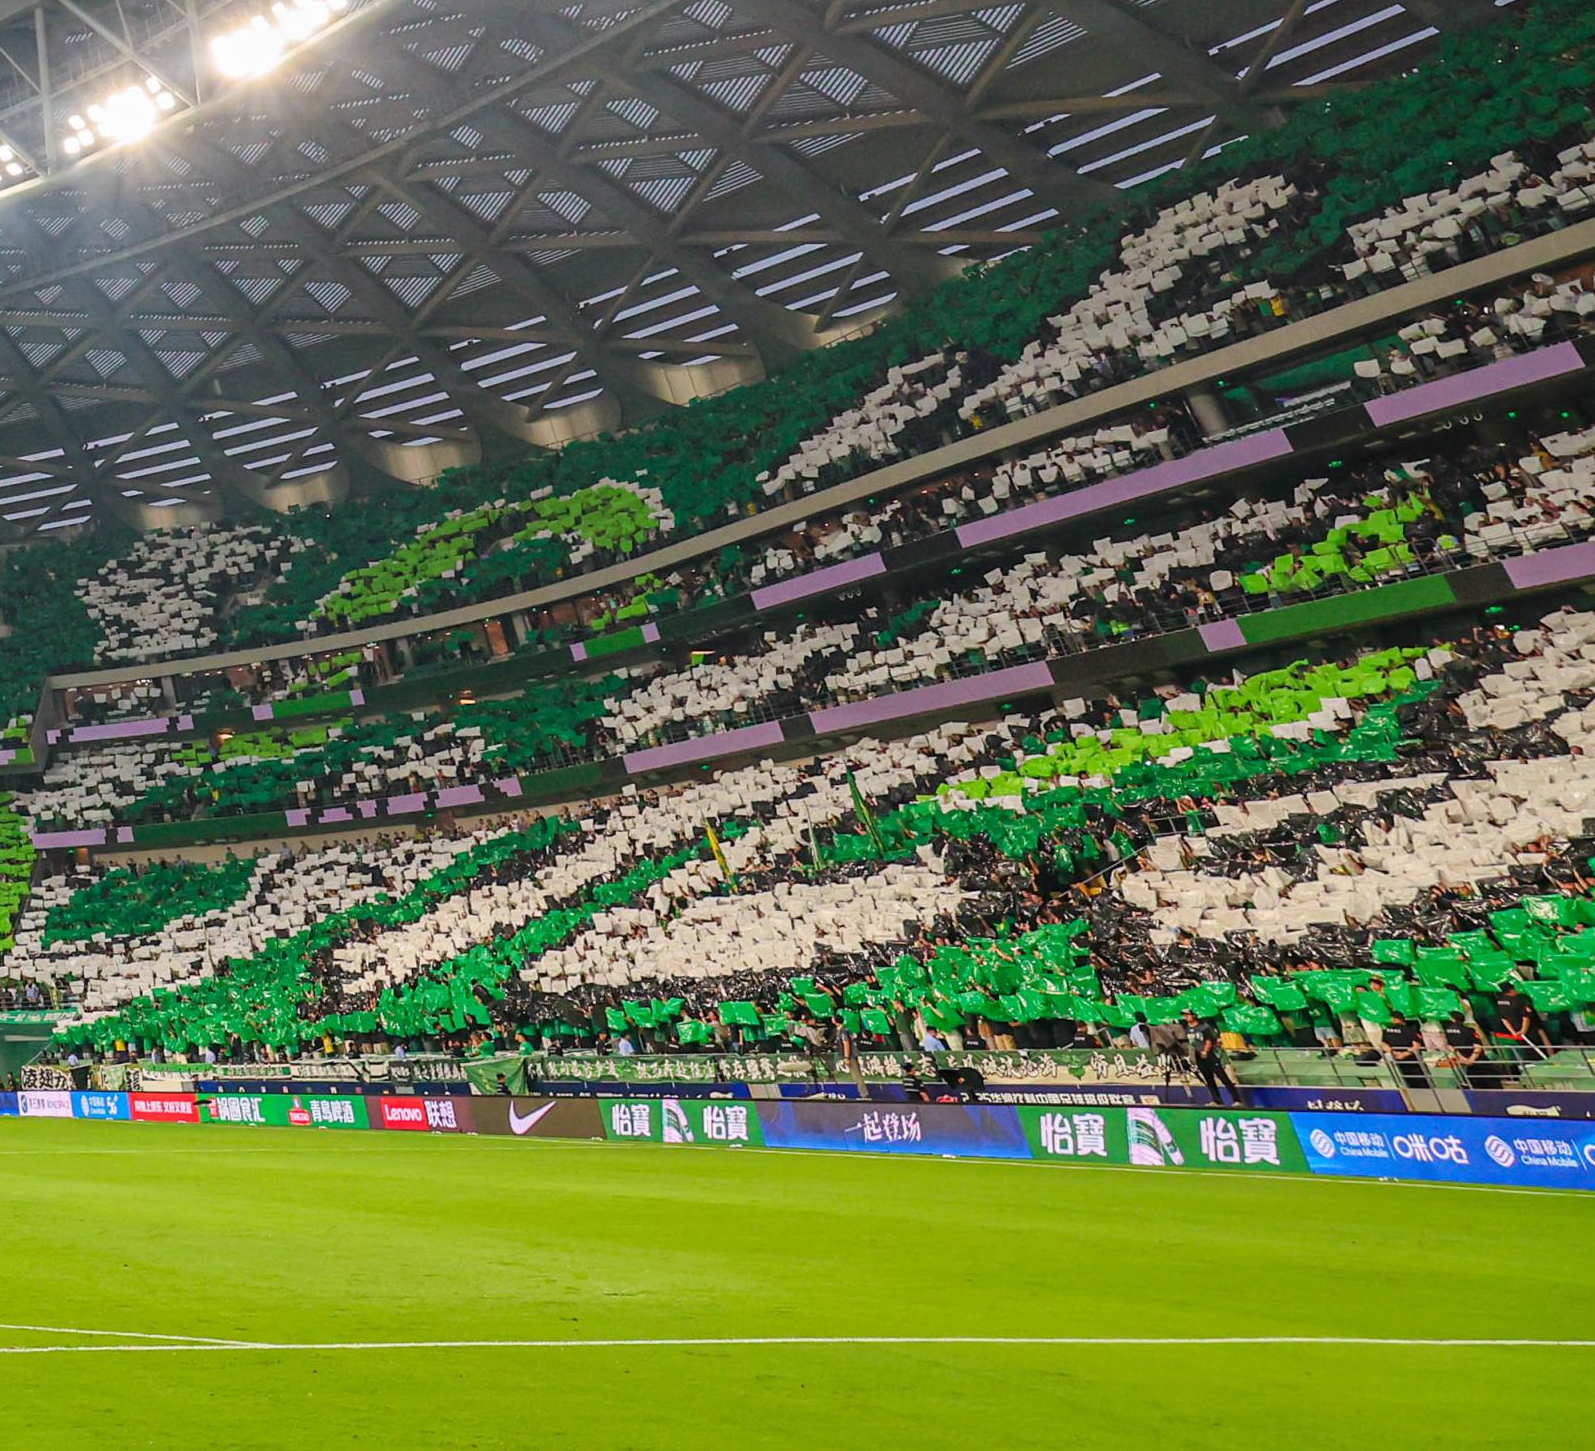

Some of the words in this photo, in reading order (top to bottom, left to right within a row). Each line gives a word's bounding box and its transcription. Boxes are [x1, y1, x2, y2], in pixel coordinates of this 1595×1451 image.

[218, 1097, 266, 1122] 锅圈食汇
[309, 1099, 355, 1123] 青岛啤酒
[384, 1104, 423, 1122] Lenovo
[423, 1100, 457, 1129] 联想
[611, 1103, 651, 1137] 怡寶
[703, 1105, 748, 1141] 怡寶
[844, 1110, 921, 1143] 一起登场
[1040, 1112, 1108, 1157] 怡寶
[1199, 1116, 1280, 1166] 怡寶
[1334, 1131, 1384, 1148] 中国移动
[1514, 1138, 1573, 1157] 中国移动
[1340, 1148, 1362, 1157] China
[1362, 1148, 1389, 1159] Mobile
[1521, 1155, 1548, 1167] China
[1548, 1156, 1579, 1169] Mobile
